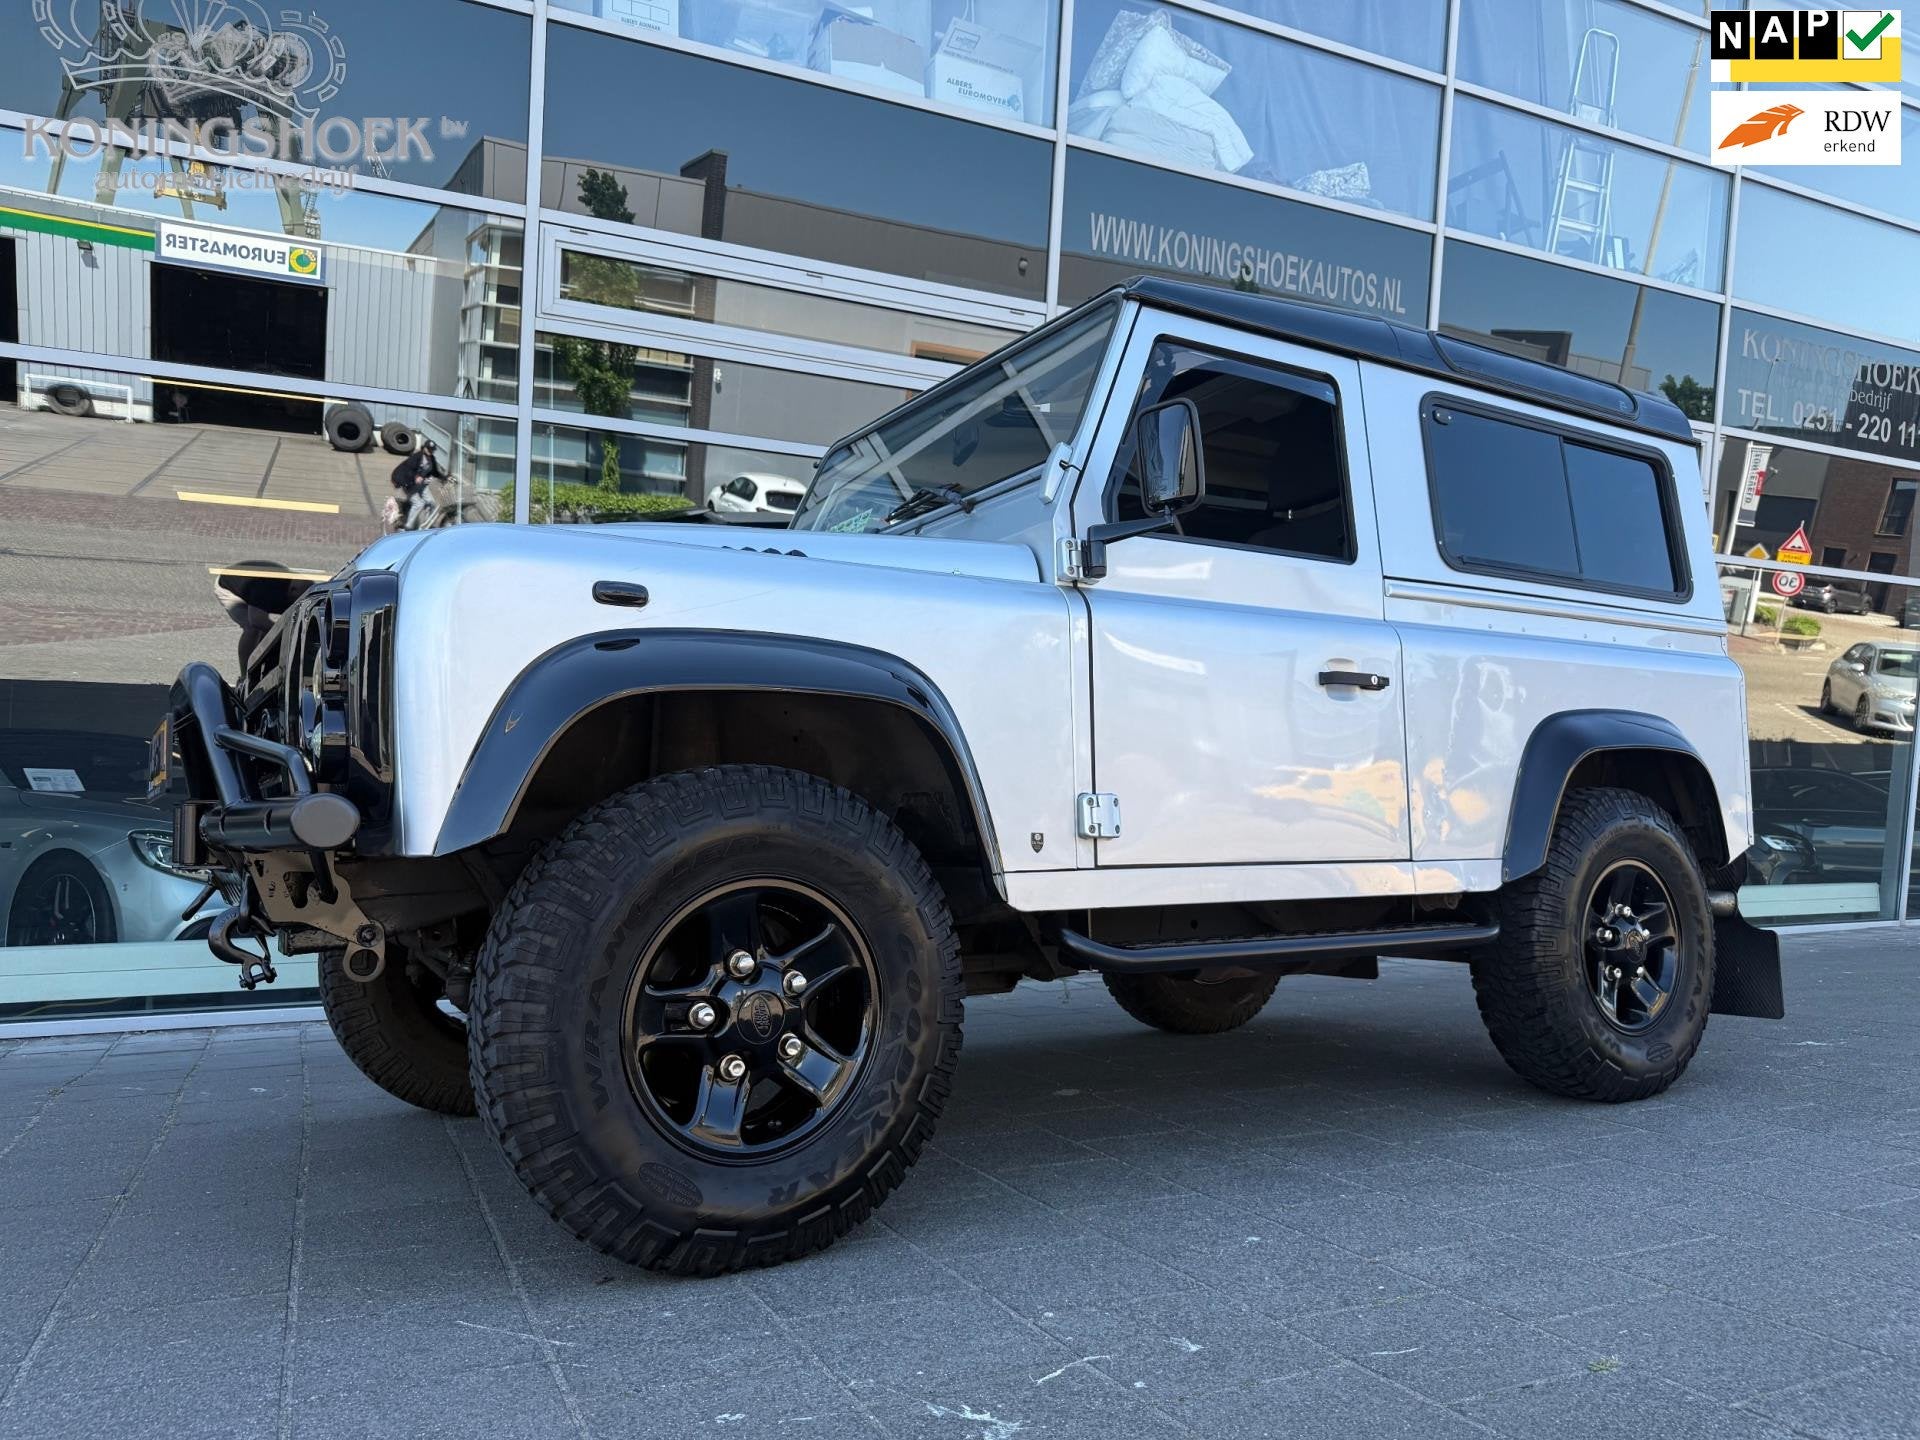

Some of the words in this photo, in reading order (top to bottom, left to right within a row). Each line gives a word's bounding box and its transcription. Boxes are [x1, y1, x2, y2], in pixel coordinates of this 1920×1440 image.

[946, 77, 973, 89] ALBERS
[1089, 212, 1407, 315] WWW.KONINGSHOEKAUTOS.NL
[1738, 388, 1784, 423] TEL.
[1791, 400, 1839, 433] 0251
[1857, 412, 1892, 444] 220
[1898, 420, 1920, 448] 11
